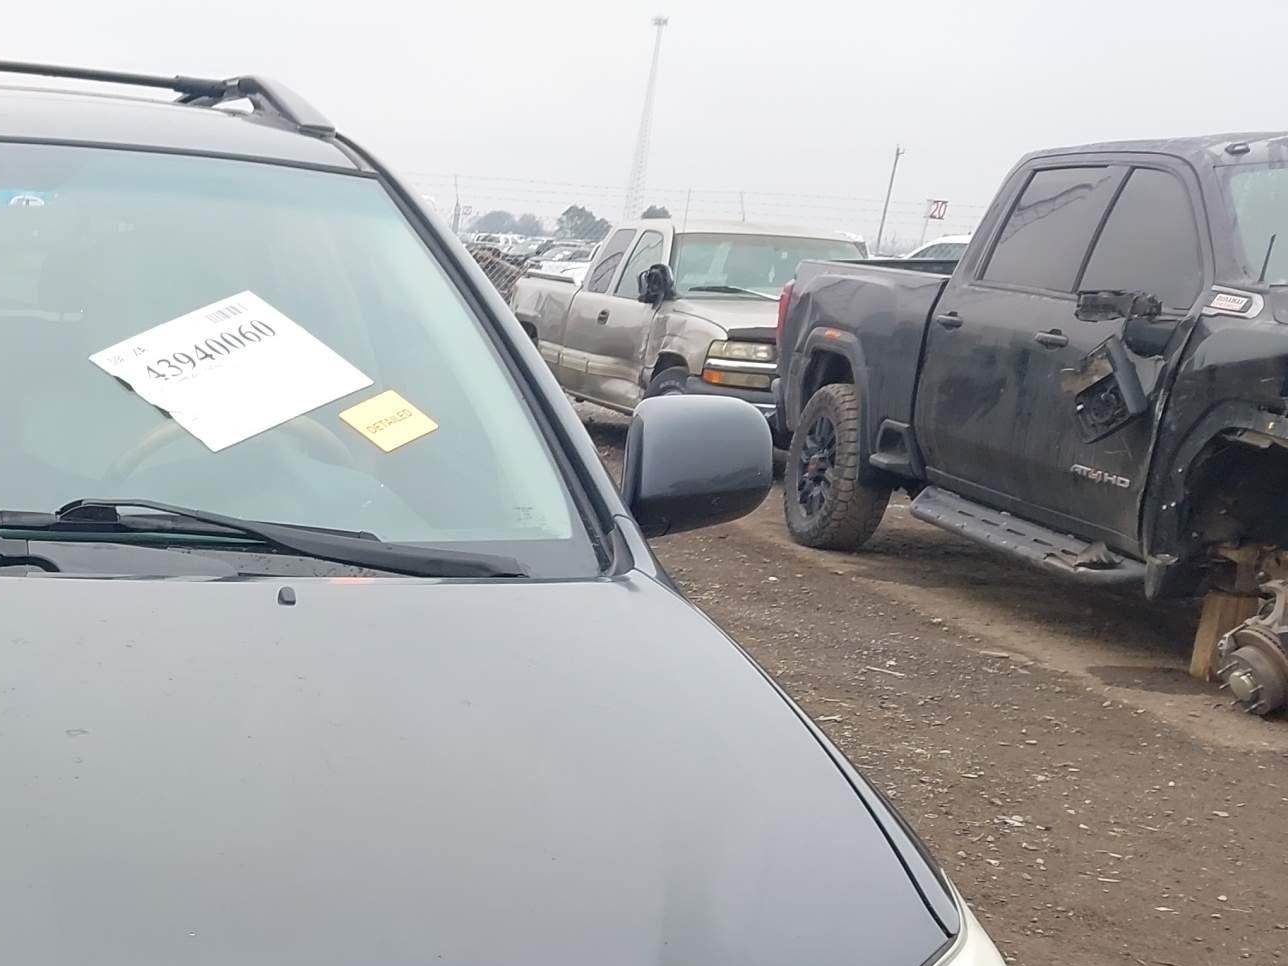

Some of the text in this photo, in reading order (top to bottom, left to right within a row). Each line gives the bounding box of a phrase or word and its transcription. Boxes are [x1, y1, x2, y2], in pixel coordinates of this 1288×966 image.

[929, 200, 948, 220] 20
[145, 319, 277, 381] 43940060
[365, 408, 413, 434] DETAILED
